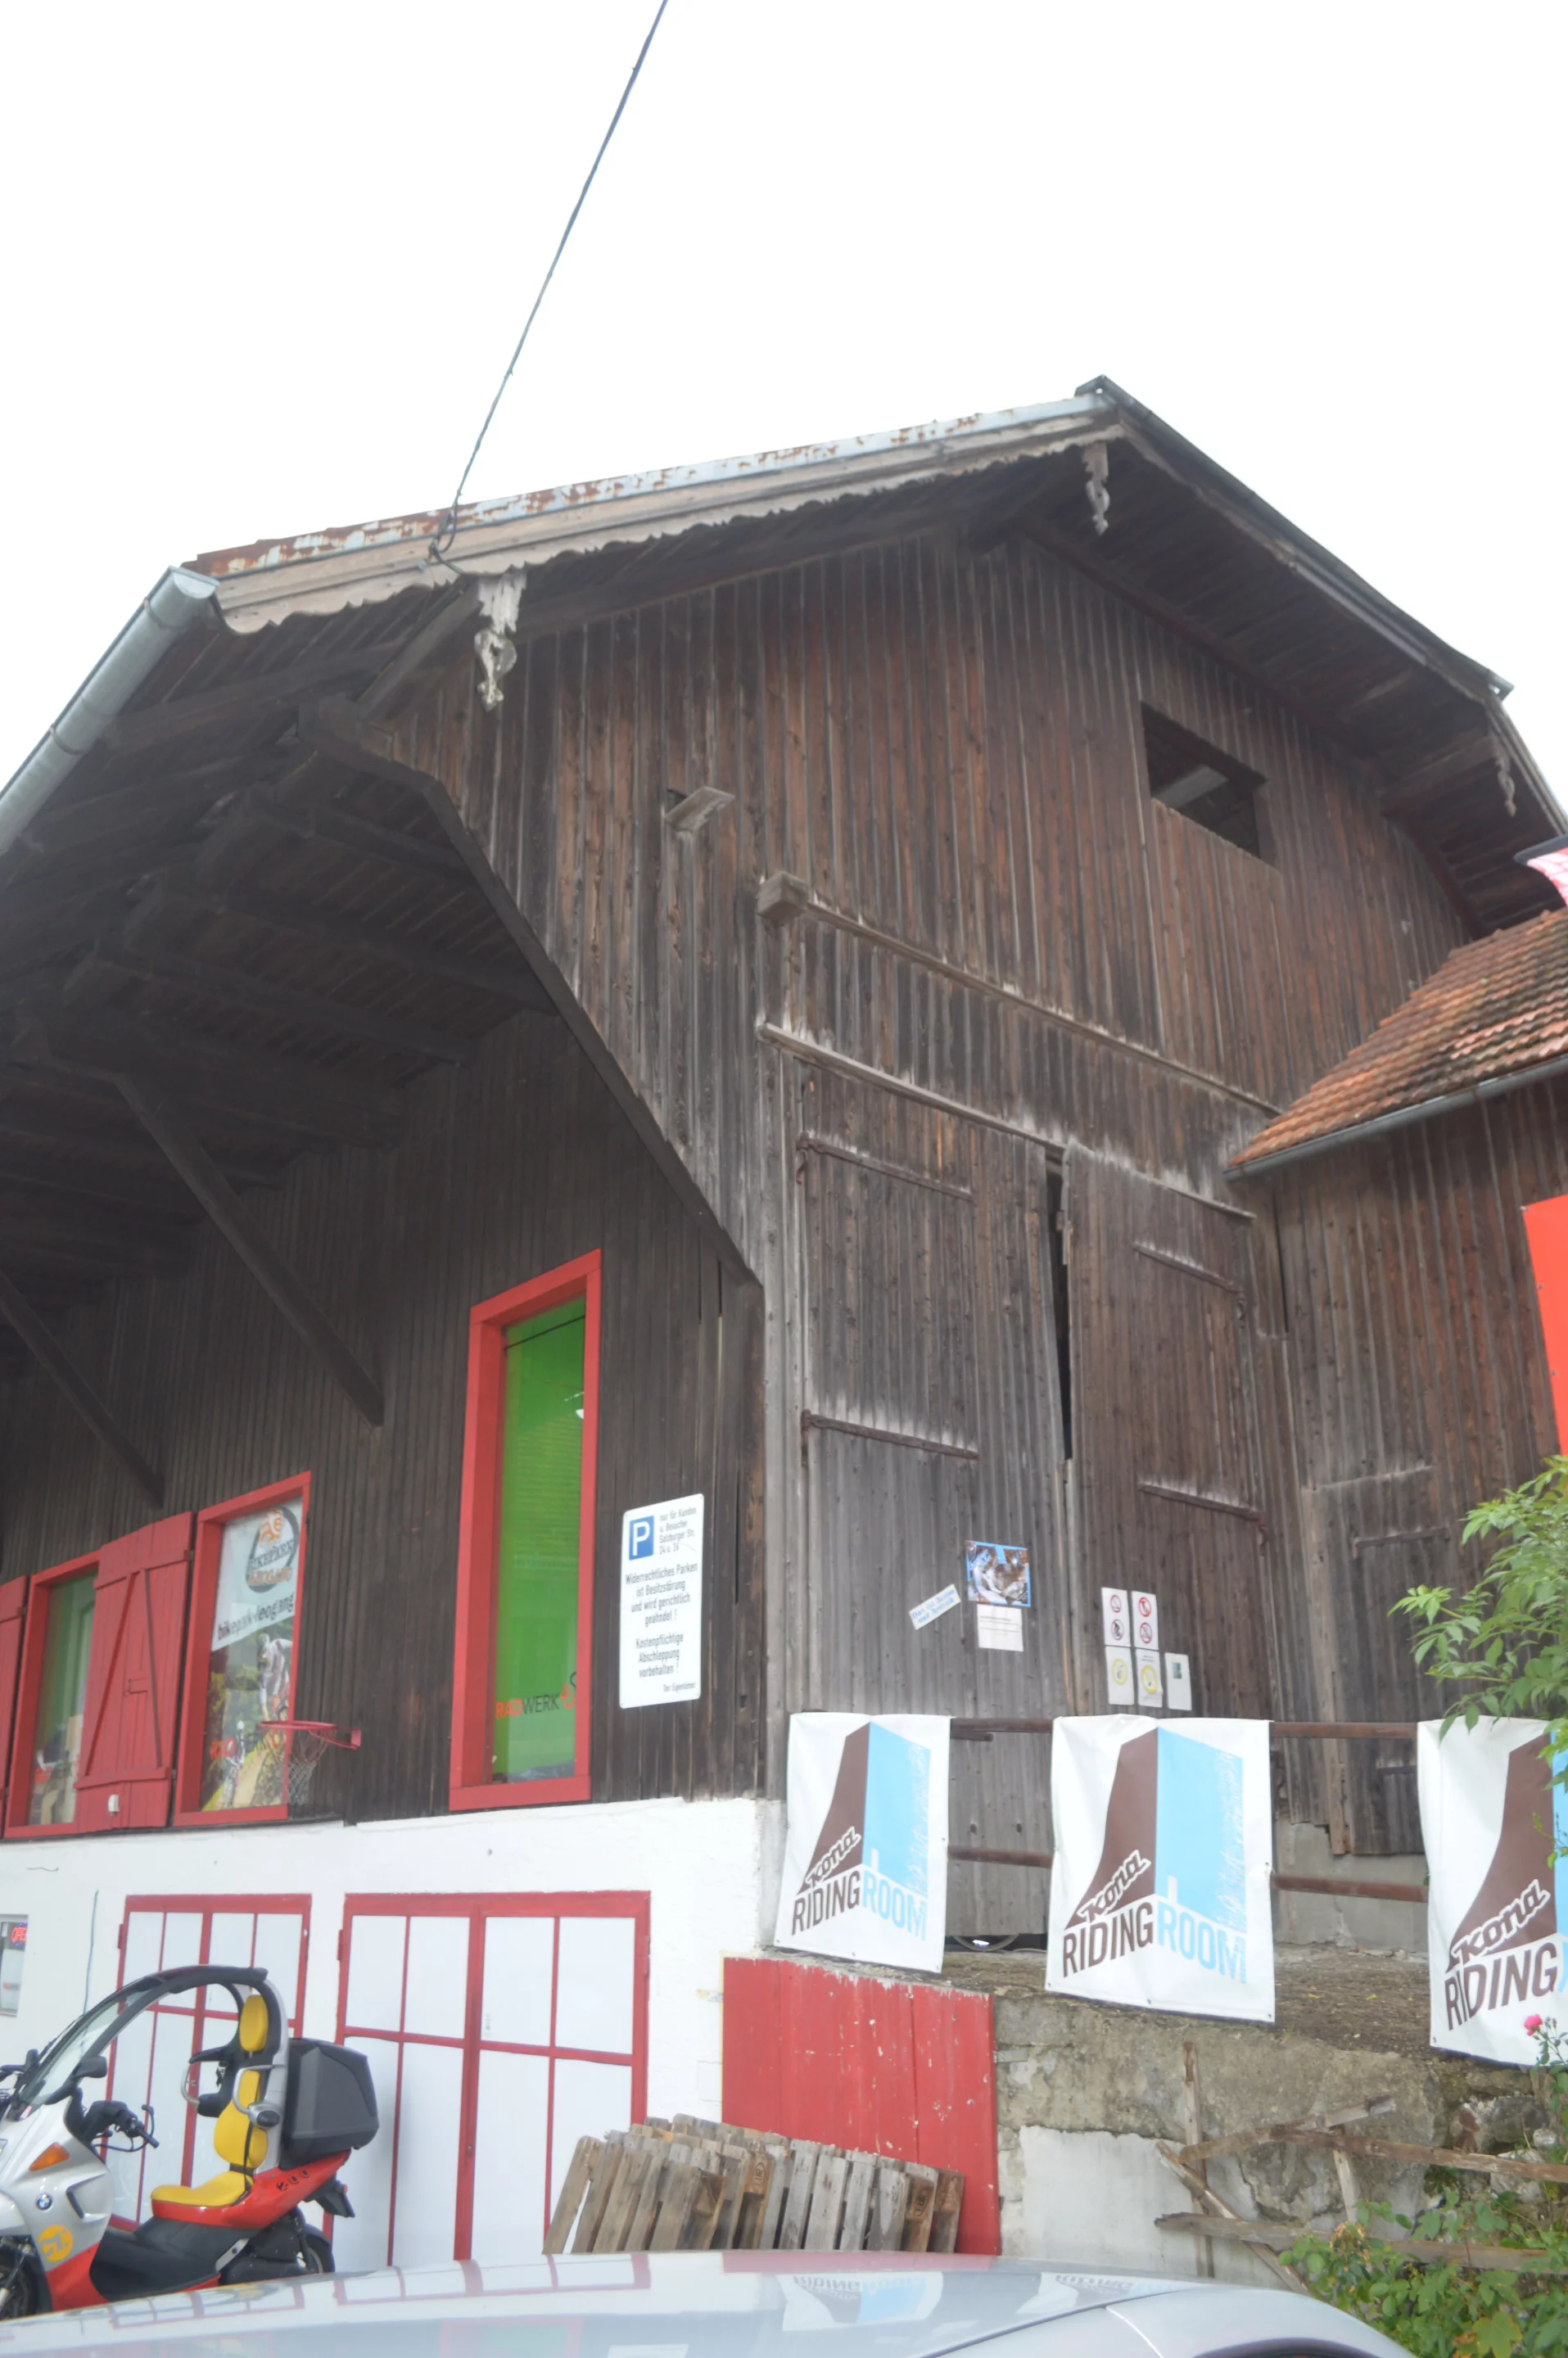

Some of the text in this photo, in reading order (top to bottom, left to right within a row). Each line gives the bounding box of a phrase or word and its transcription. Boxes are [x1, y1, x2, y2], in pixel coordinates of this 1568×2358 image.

[678, 1506, 697, 1517] Kunden
[666, 1520, 688, 1531] Besucher
[632, 1520, 650, 1556] P
[659, 1532, 685, 1543] Salzburger
[626, 1562, 698, 1584] Widerrechtliches Parken
[645, 1580, 685, 1596] Besitzstörung
[631, 1592, 690, 1613] und wird gerichtlich
[645, 1610, 672, 1628] geahndet
[635, 1632, 684, 1649] Kostenpflichtige
[639, 1649, 680, 1663] Abschleppung
[639, 1664, 674, 1678] vorbehalten
[495, 1692, 560, 1719] RADWERK
[791, 1869, 928, 1941] RIDING ROOM
[1063, 1900, 1247, 1985] RIDING ROOM
[1444, 1941, 1558, 2031] RIDING
